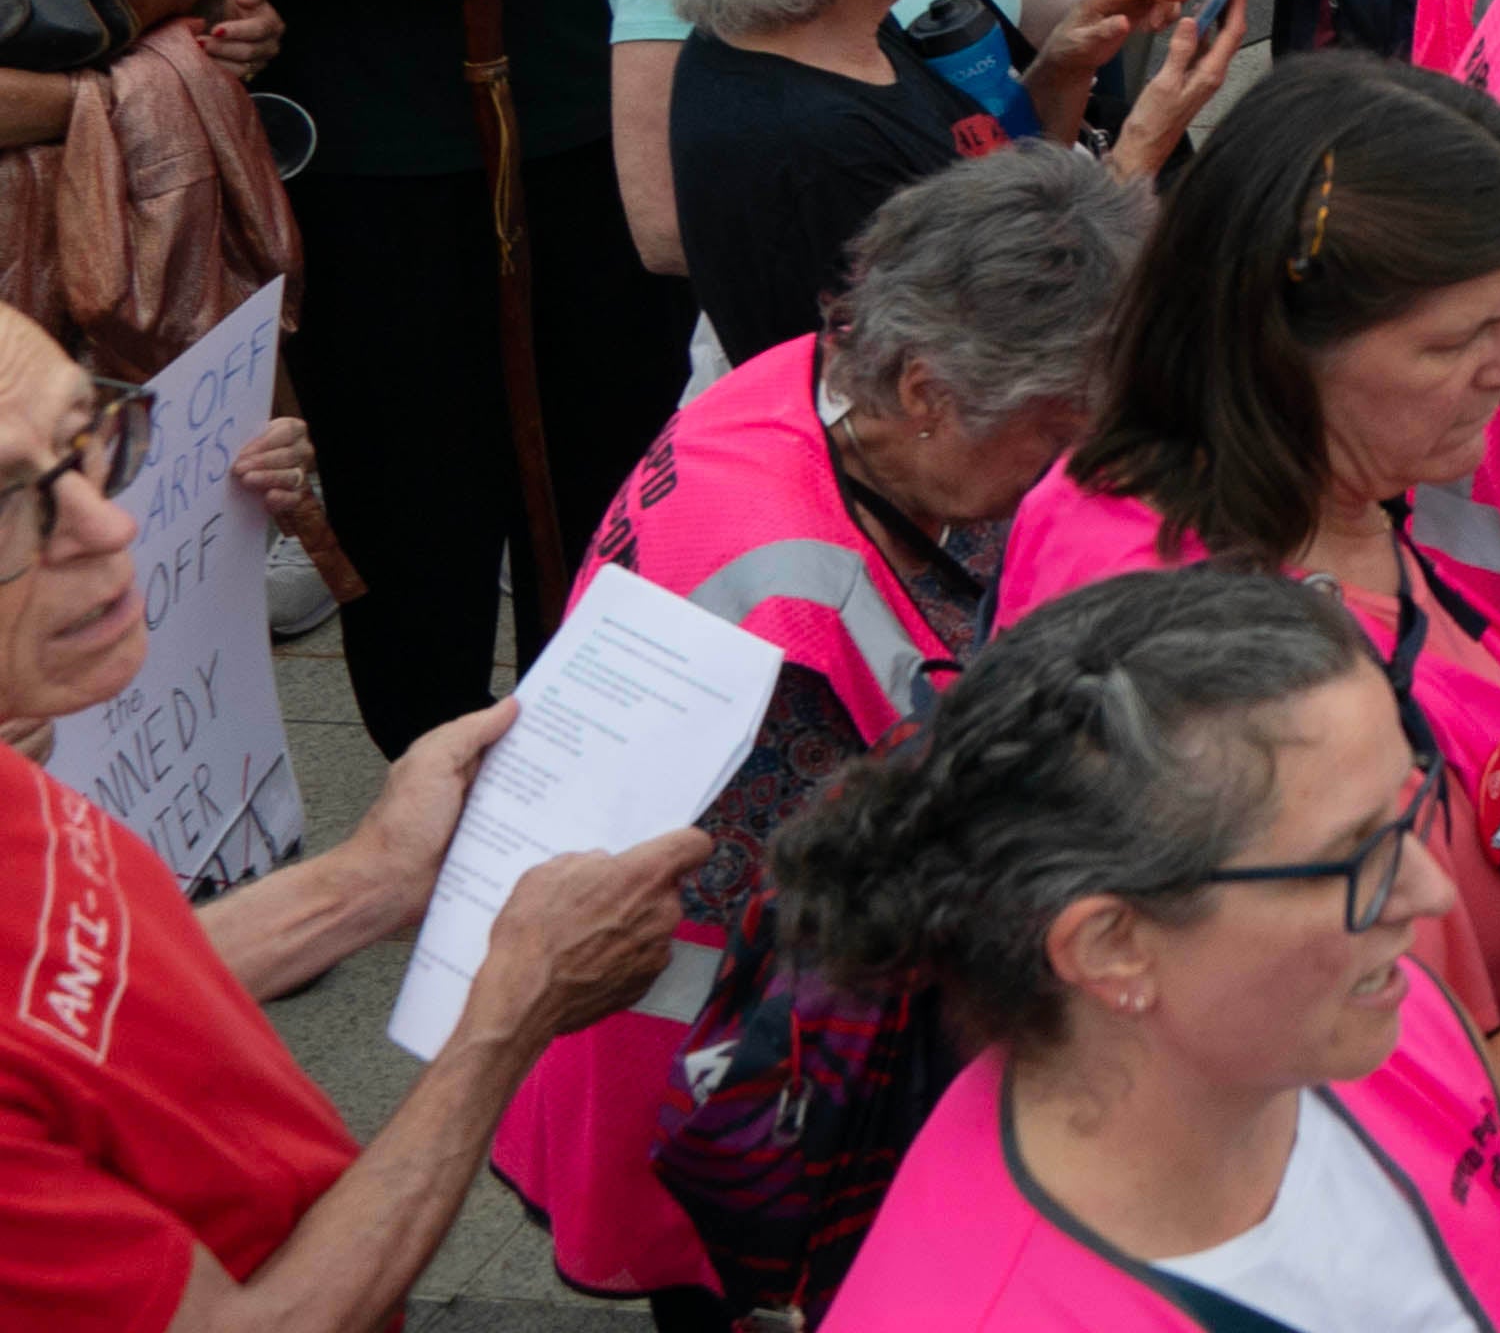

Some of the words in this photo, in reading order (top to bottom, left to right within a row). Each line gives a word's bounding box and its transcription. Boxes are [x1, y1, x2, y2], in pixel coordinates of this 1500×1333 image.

[186, 319, 274, 415] OFF
[138, 418, 239, 545] ARTS
[144, 511, 225, 633] OFF
[94, 646, 223, 820] NNEDY
[102, 687, 146, 736] the
[146, 761, 225, 870] NTER
